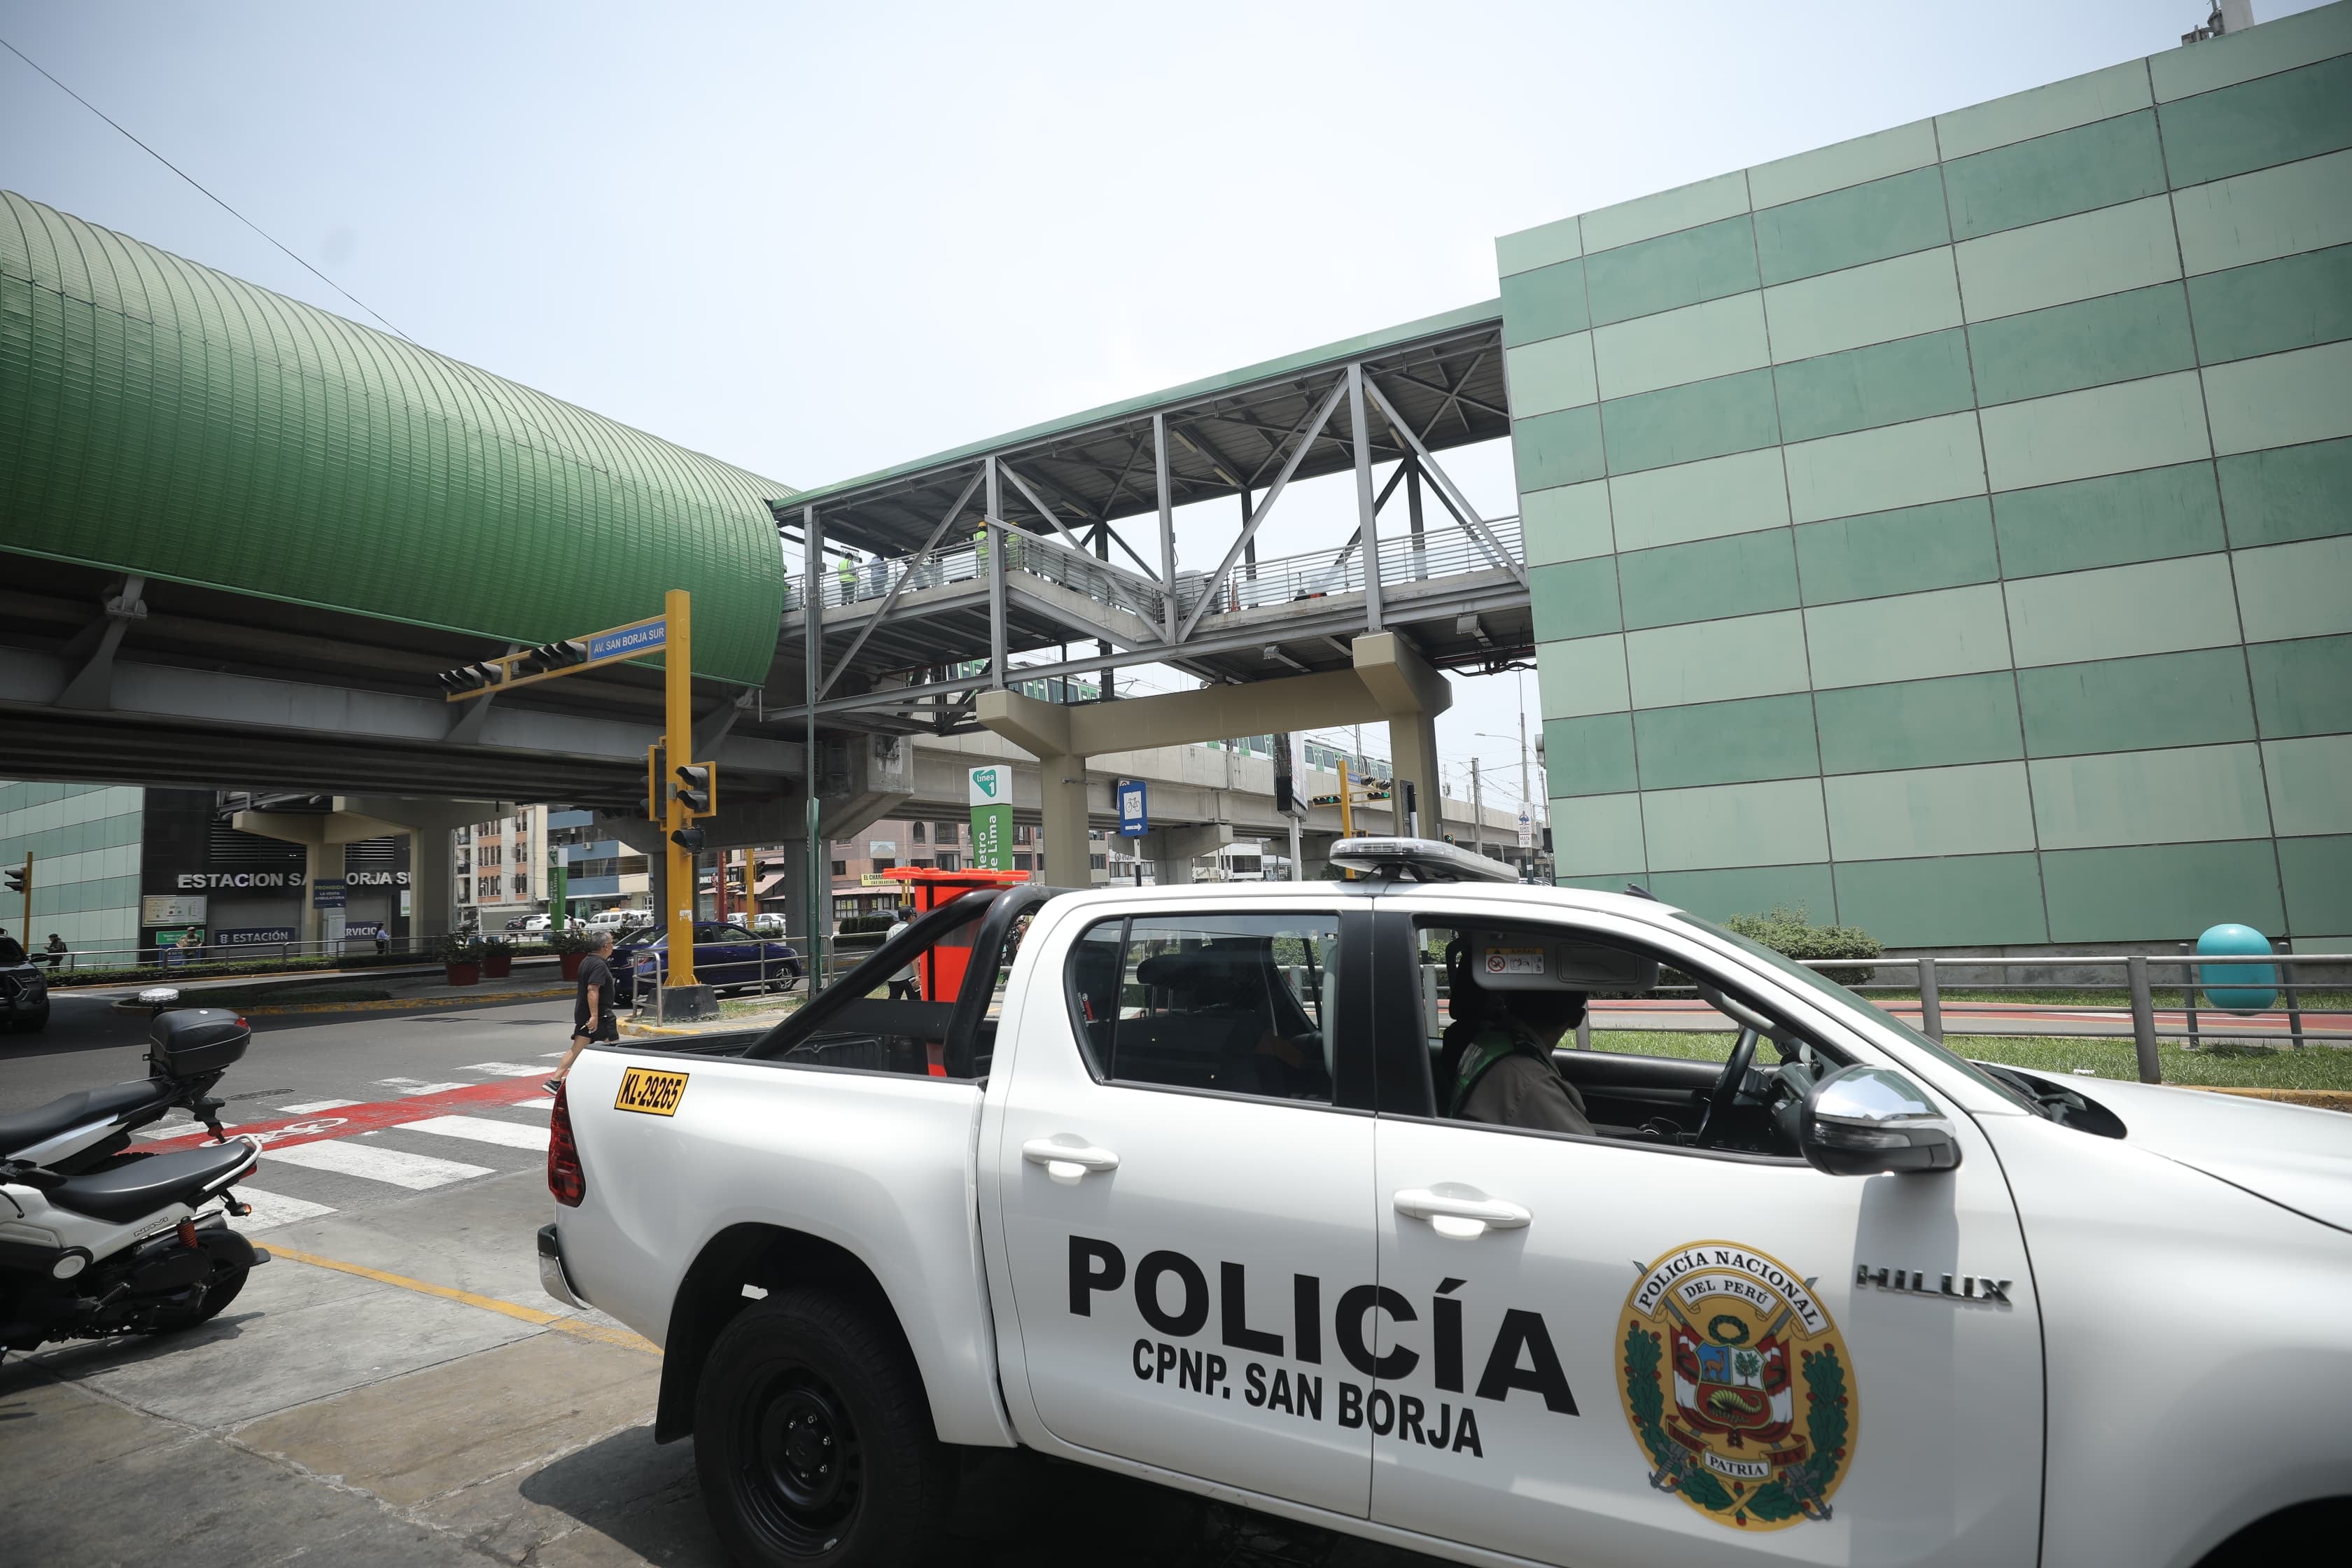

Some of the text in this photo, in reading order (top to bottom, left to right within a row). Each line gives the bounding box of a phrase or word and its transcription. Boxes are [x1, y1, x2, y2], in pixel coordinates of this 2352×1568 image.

[594, 627, 664, 654] AV. SAN BORJA SUR
[988, 782, 995, 794] 1
[988, 815, 997, 853] Lima
[978, 832, 986, 869] etro
[178, 874, 284, 888] ESTACION
[346, 872, 393, 886] ORJA
[233, 930, 288, 943] ESTACIÓN
[346, 927, 377, 937] RVICIO
[620, 1073, 682, 1110] KL-29265
[1639, 1250, 1819, 1326] POLICÍA NACIONAL
[1684, 1280, 1768, 1304] DEL PERÚ
[1856, 1264, 2013, 1306] HILUX
[1069, 1235, 1580, 1417] POLICÍA
[1133, 1338, 1483, 1459] CPNP. SAN BORJA
[1709, 1456, 1765, 1476] PATRIA
